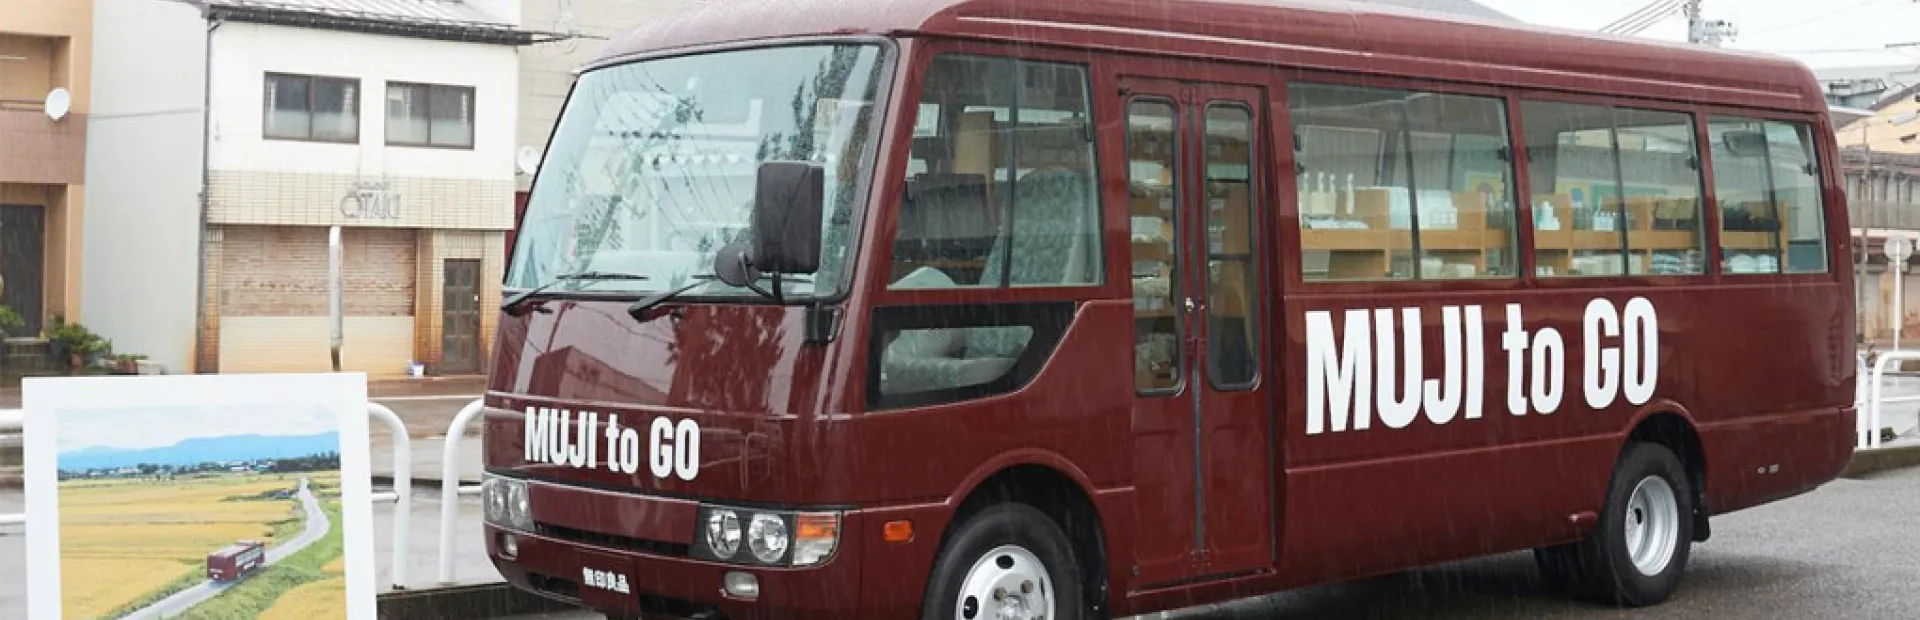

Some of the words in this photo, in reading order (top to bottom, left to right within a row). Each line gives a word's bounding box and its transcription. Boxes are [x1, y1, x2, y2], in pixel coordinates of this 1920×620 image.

[1305, 304, 1484, 435] MUJI
[1502, 303, 1565, 416] to
[1583, 297, 1659, 410] GO
[524, 406, 598, 469] MUJI
[605, 413, 639, 475] to
[650, 415, 700, 481] GO
